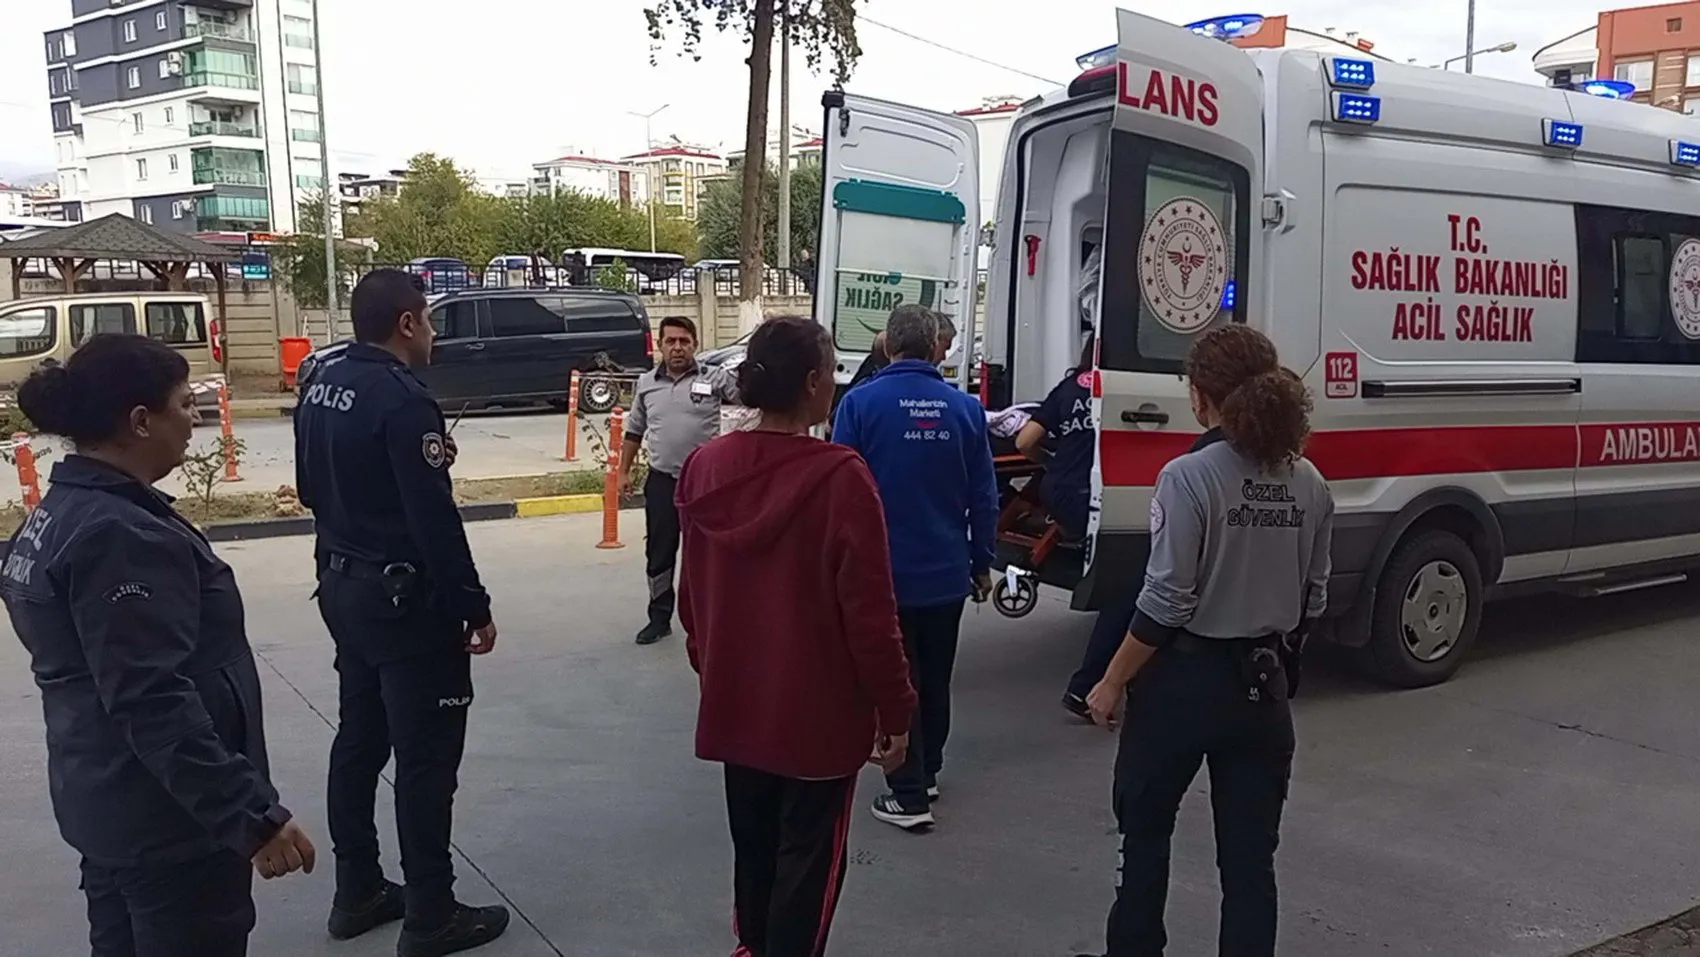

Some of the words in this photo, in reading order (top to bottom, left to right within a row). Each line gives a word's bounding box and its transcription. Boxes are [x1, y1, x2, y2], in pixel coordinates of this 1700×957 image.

[1118, 61, 1218, 126] LANS
[1448, 214, 1488, 254] T.C.
[1351, 246, 1440, 293] SAĞLIK
[1454, 258, 1568, 300] BAKANLIĞI
[1391, 297, 1446, 341] ACİL
[1455, 300, 1534, 342] SAĞLIK
[1330, 358, 1353, 379] 112
[903, 430, 921, 440] 444
[924, 430, 936, 440] 82
[938, 430, 951, 440] 40
[1600, 426, 1700, 462] AMBULA
[1241, 478, 1296, 502] ÖZEL
[1227, 503, 1305, 528] GÜVENLİK
